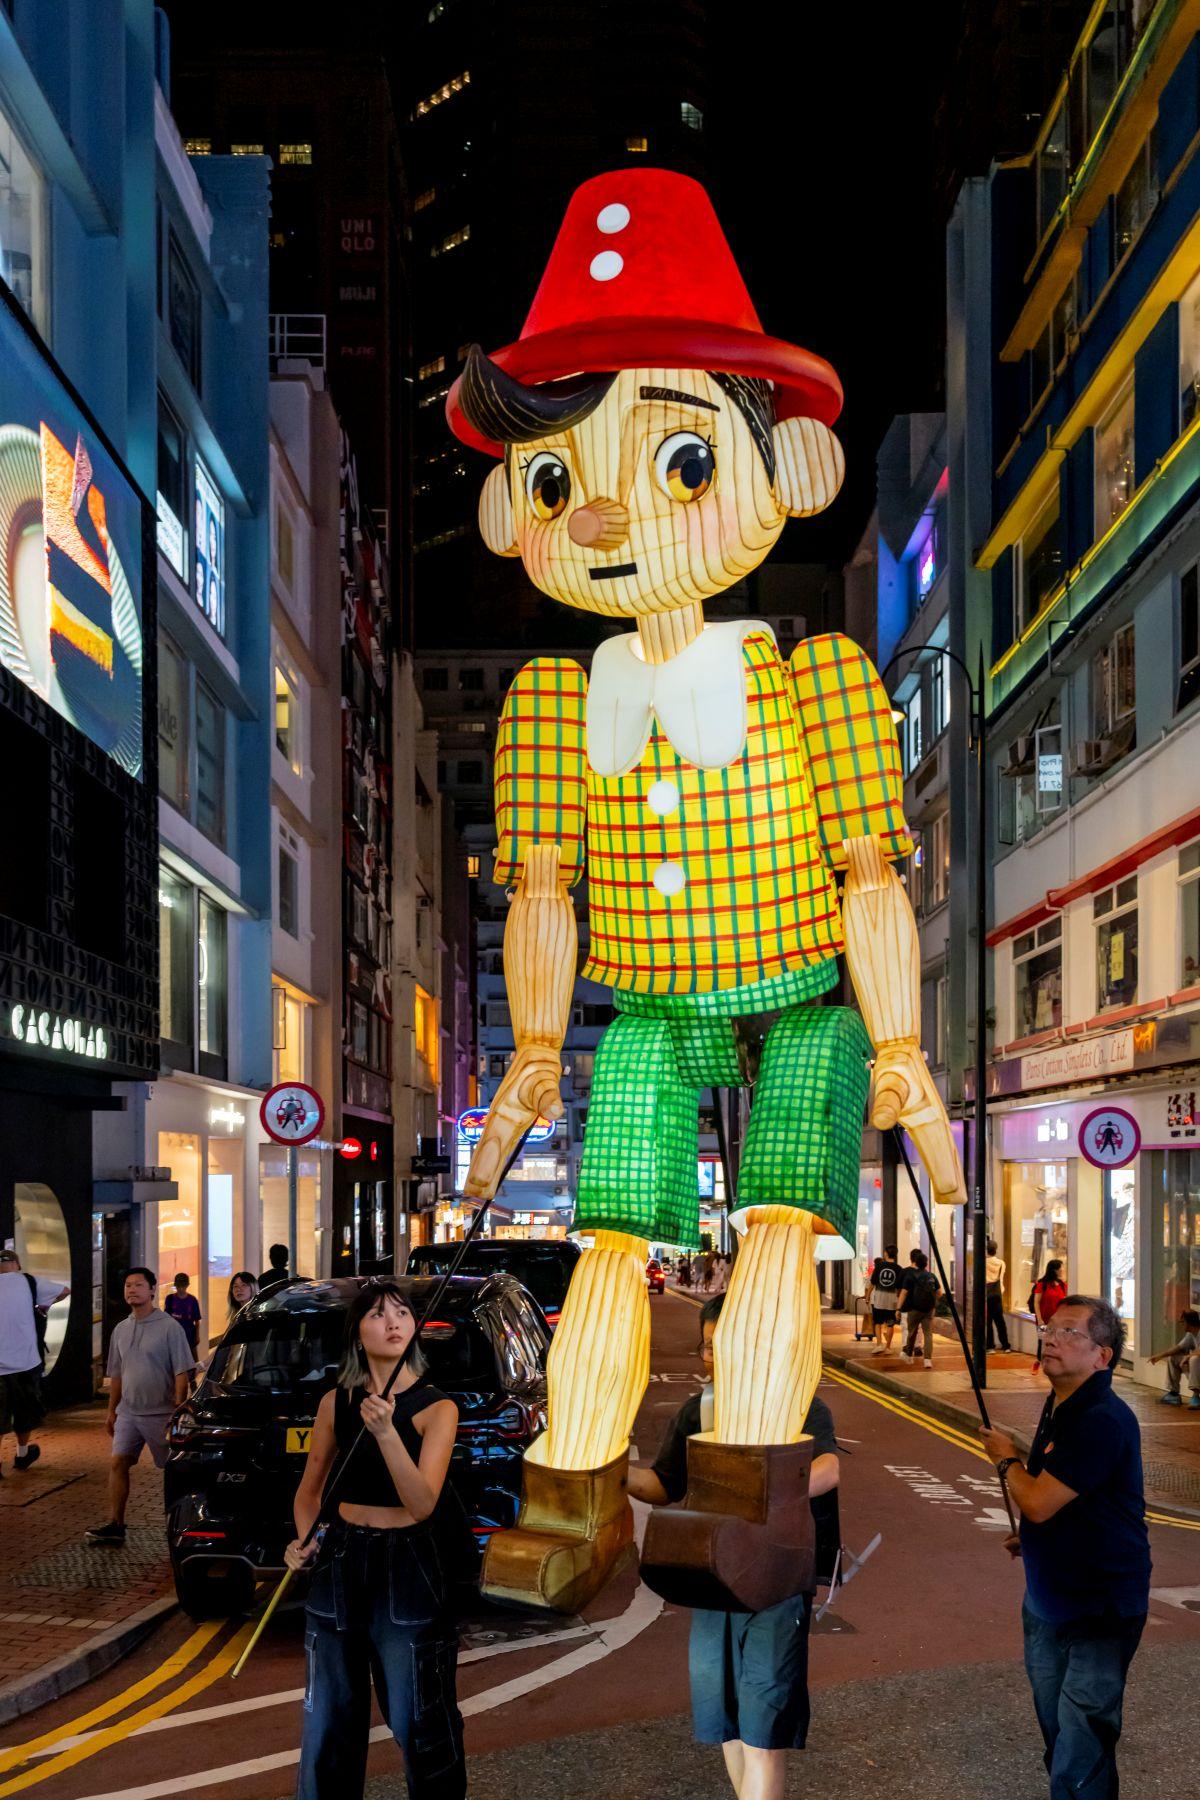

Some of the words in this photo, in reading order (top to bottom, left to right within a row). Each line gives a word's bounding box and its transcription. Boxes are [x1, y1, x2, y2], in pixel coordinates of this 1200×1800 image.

[341, 218, 373, 234] UNI
[340, 236, 375, 253] QLO
[339, 286, 377, 301] MUJI
[1063, 1045, 1093, 1078] Singlets
[295, 1430, 310, 1450] Y
